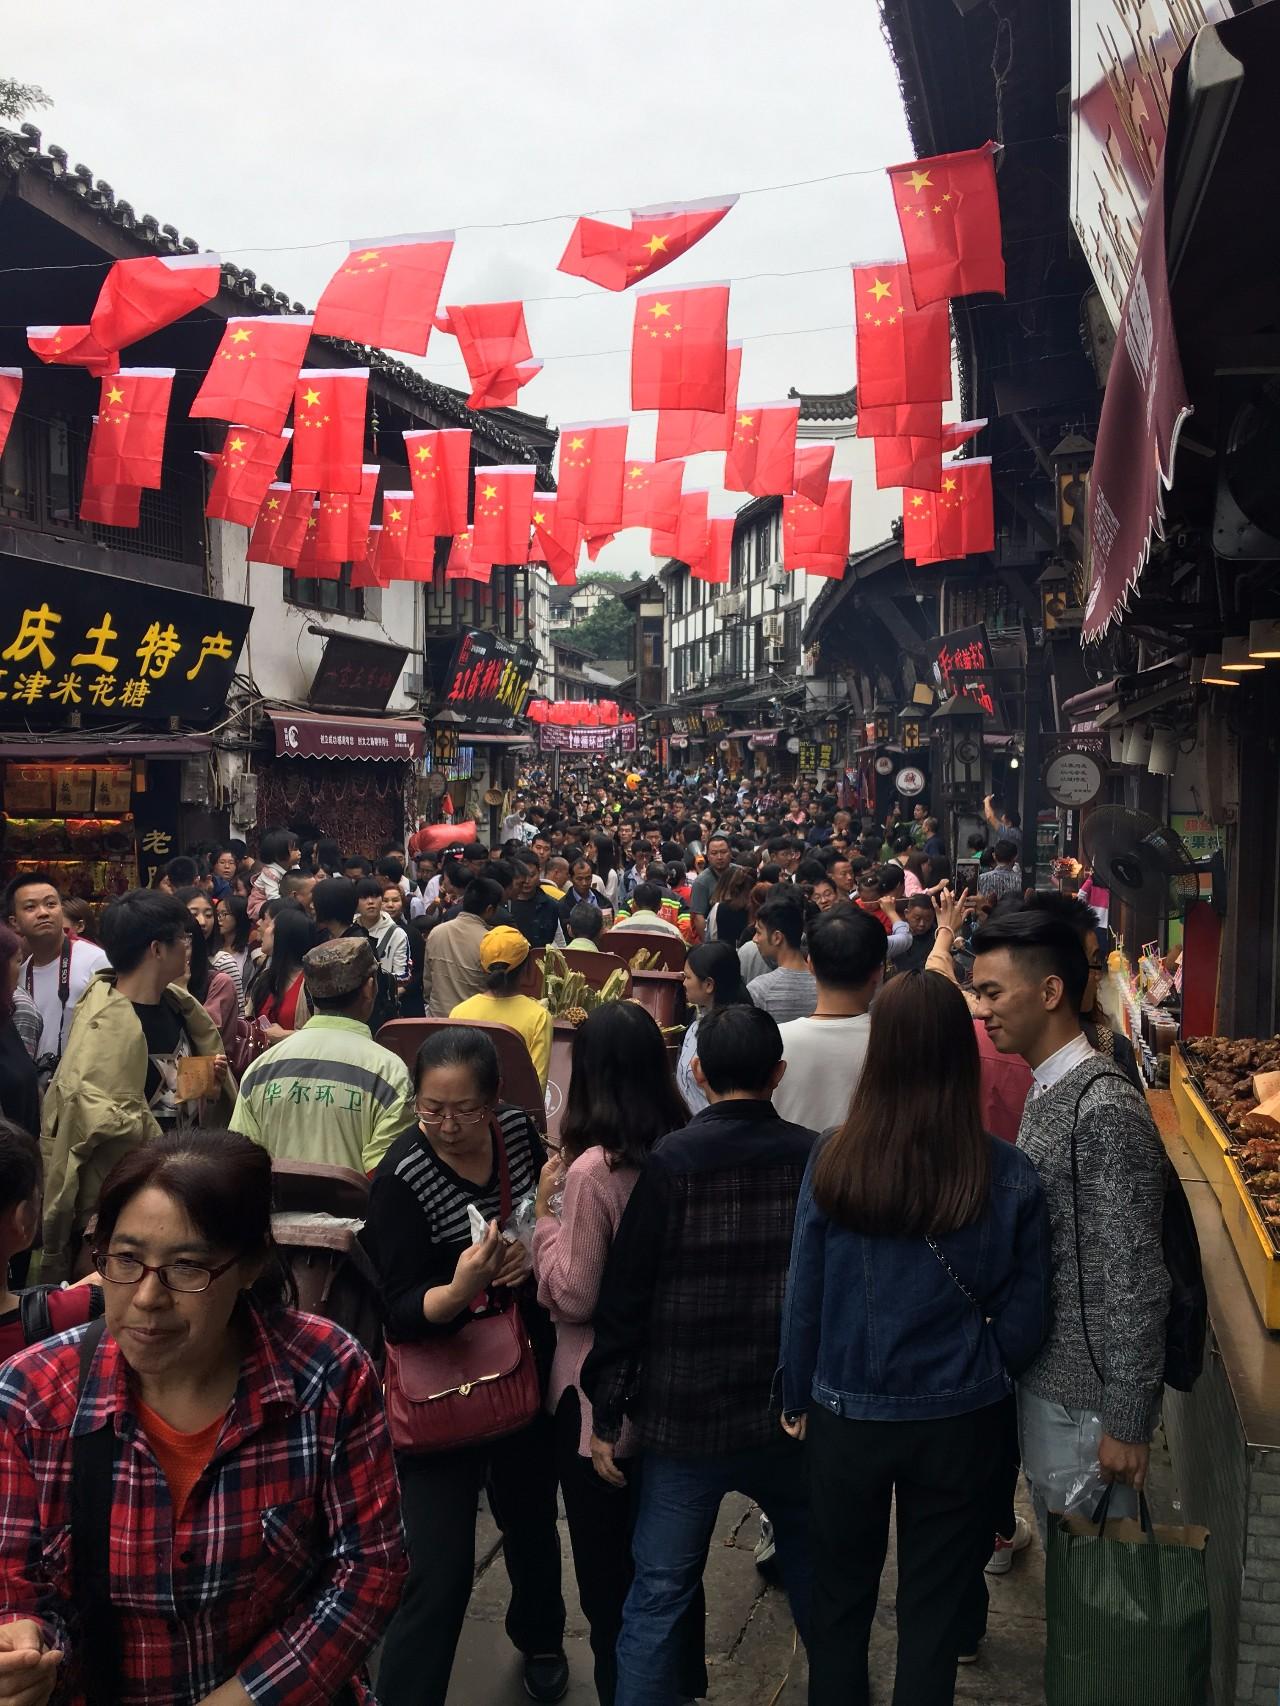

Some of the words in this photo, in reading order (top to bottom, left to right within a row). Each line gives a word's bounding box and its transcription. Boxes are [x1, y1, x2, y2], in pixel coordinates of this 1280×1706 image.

[2, 602, 234, 680] 庆土特产
[264, 1081, 362, 1112] 华尔环卫
